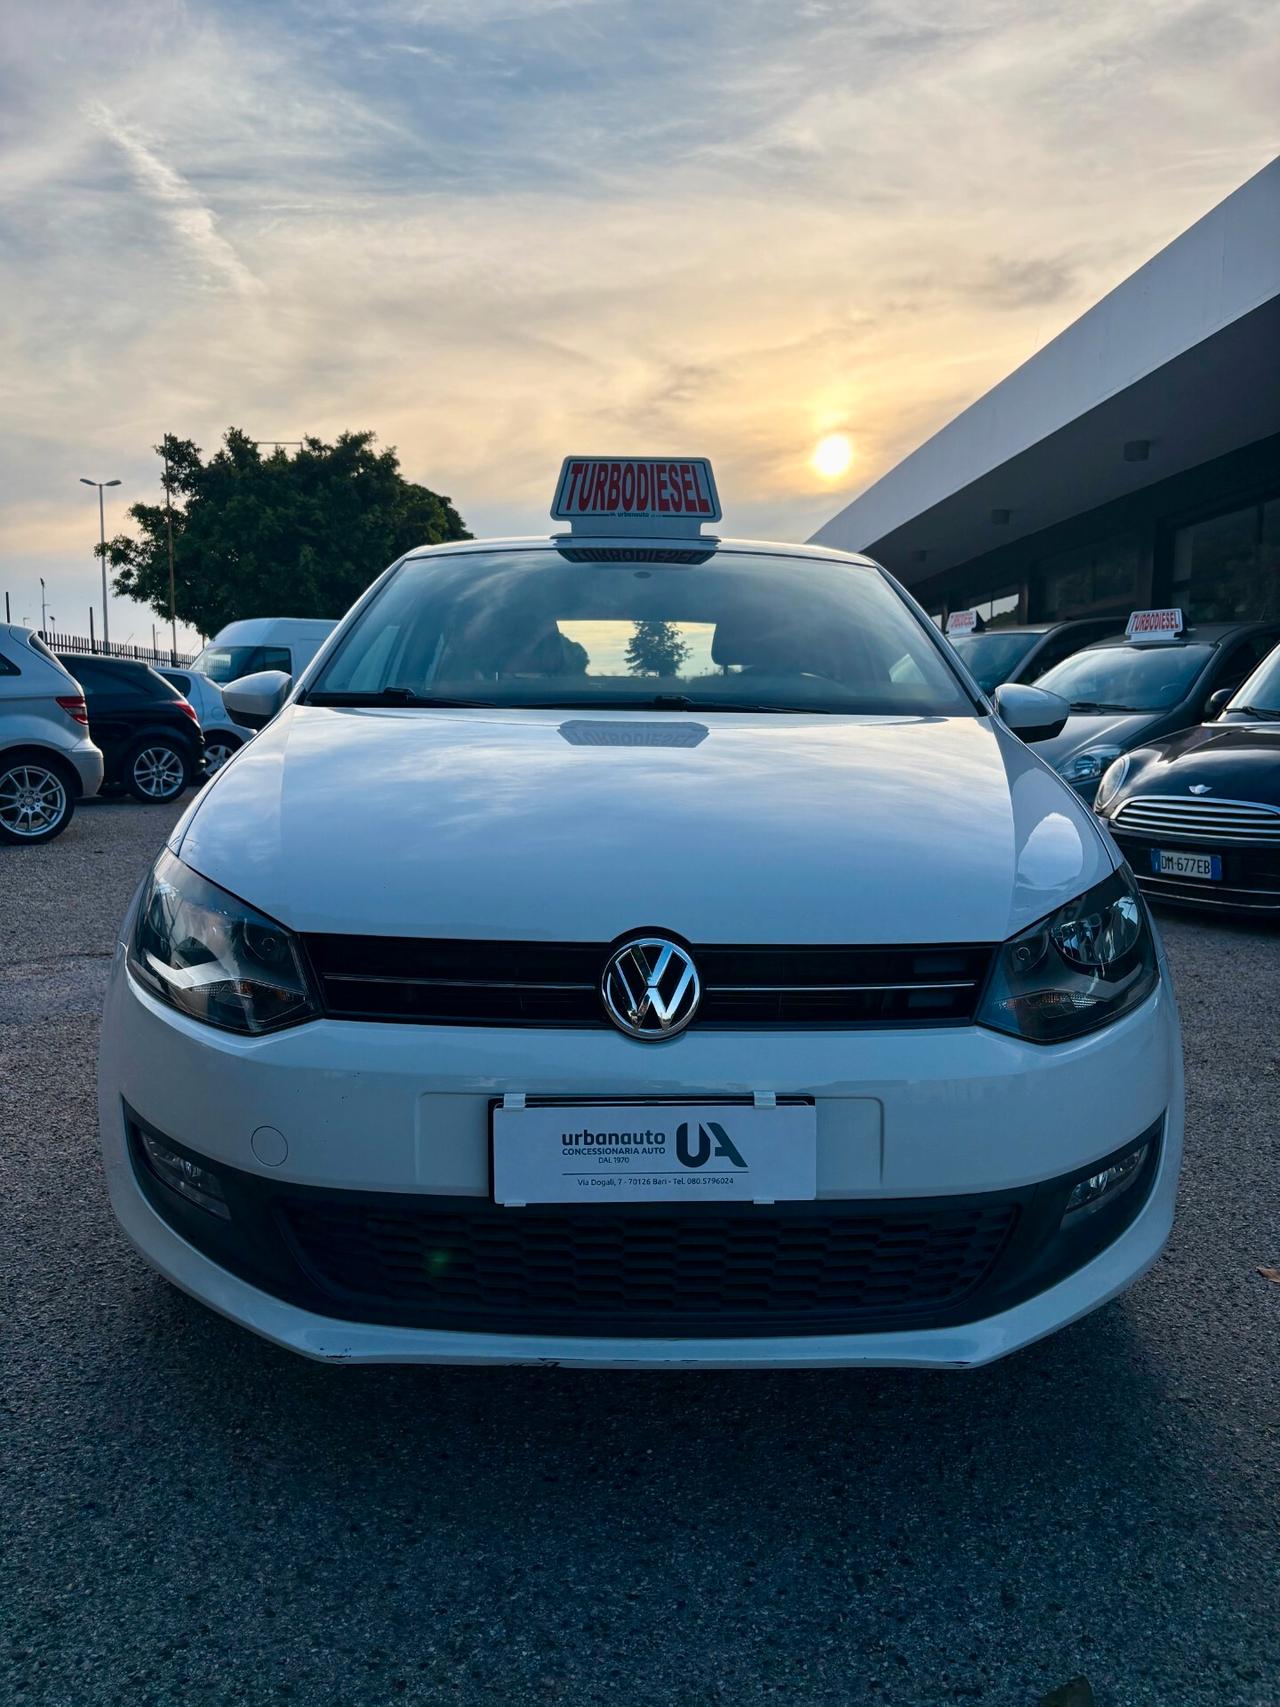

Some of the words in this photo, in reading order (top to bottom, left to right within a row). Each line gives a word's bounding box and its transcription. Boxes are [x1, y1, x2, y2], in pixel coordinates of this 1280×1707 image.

[565, 463, 711, 513] TURBODIESEL
[1131, 612, 1179, 632] TURBODIESEL
[562, 1129, 666, 1146] urbanauto
[676, 1122, 749, 1168] UA
[562, 1147, 640, 1156] CONCESSIONARIA
[641, 1147, 666, 1155] AUTO
[614, 1156, 630, 1164] 1970
[577, 1178, 589, 1186] Via
[591, 1178, 616, 1187] Dogali,
[652, 1177, 667, 1185] Bari
[673, 1177, 685, 1185] Tel.
[687, 1177, 734, 1185] 080.5796024
